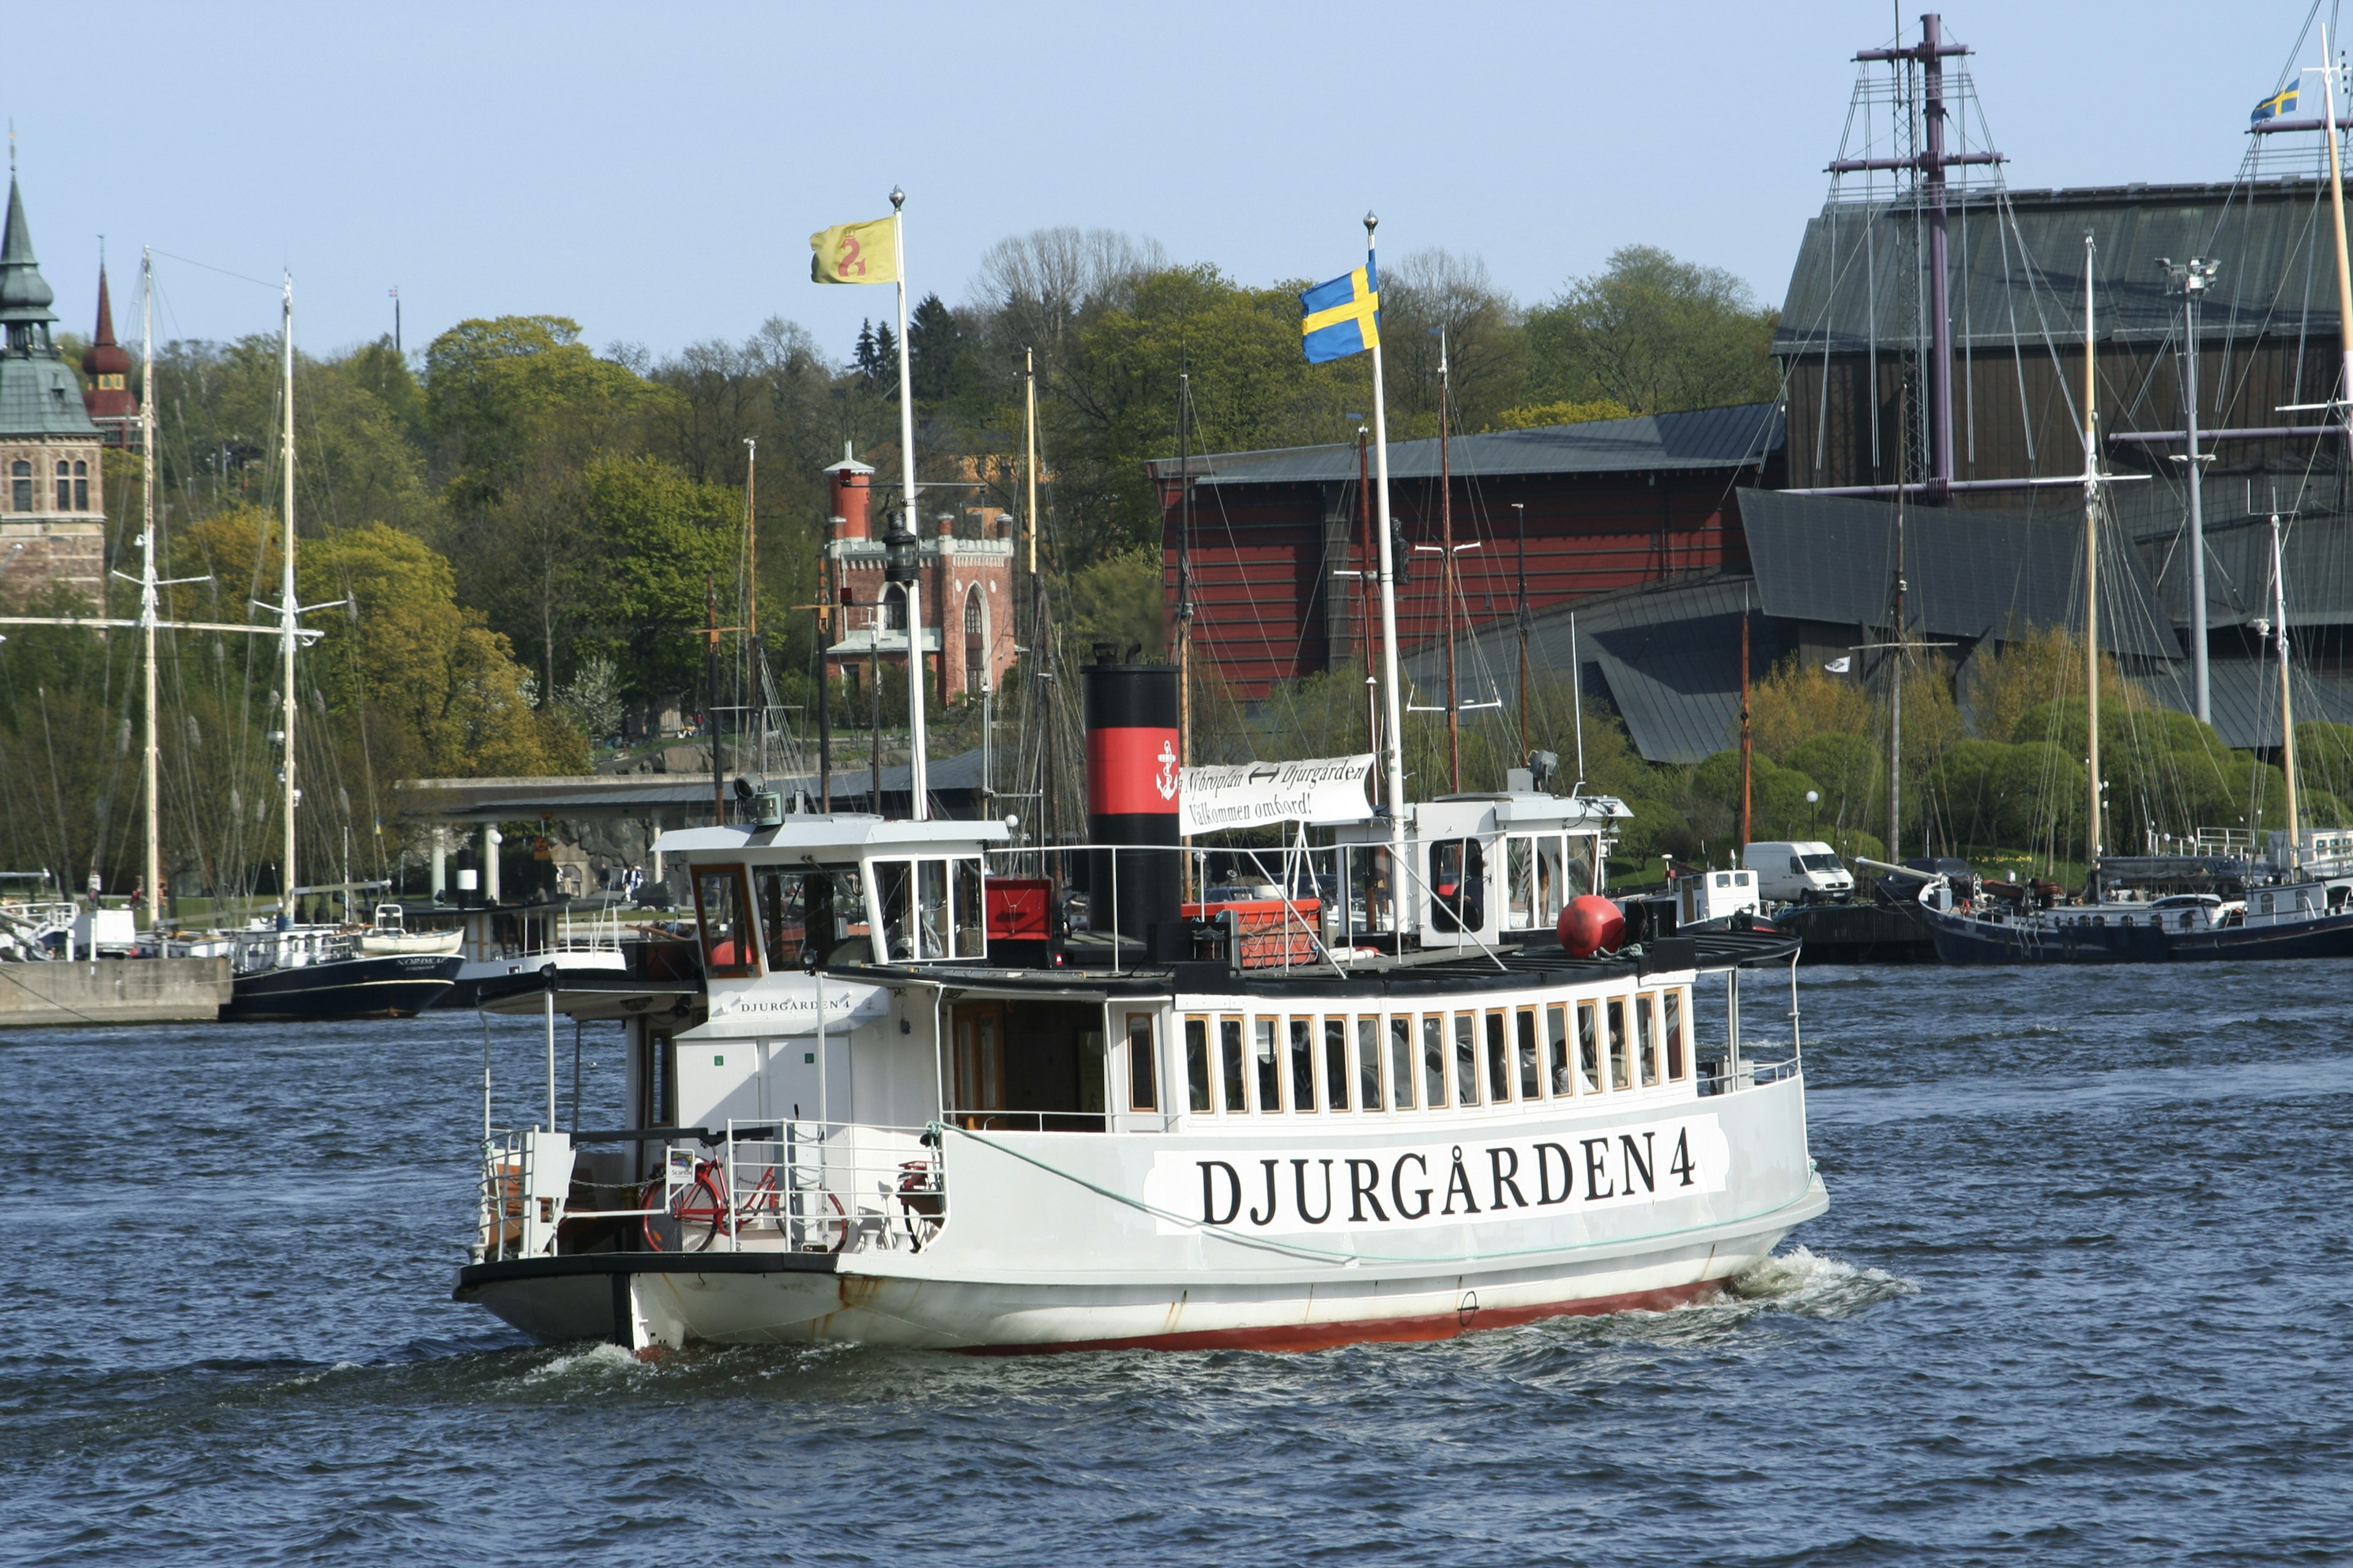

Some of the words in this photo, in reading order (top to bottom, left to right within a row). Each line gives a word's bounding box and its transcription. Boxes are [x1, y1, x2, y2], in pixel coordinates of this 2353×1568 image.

[1185, 770, 1243, 801] Nybroplan
[1280, 760, 1365, 790] Djurgården
[1189, 801, 1250, 827] Välkommen
[1255, 792, 1311, 819] ombord!
[843, 1000, 851, 1009] 4
[1196, 1131, 1656, 1225] DJURGÅRDEN
[1670, 1126, 1696, 1187] 4
